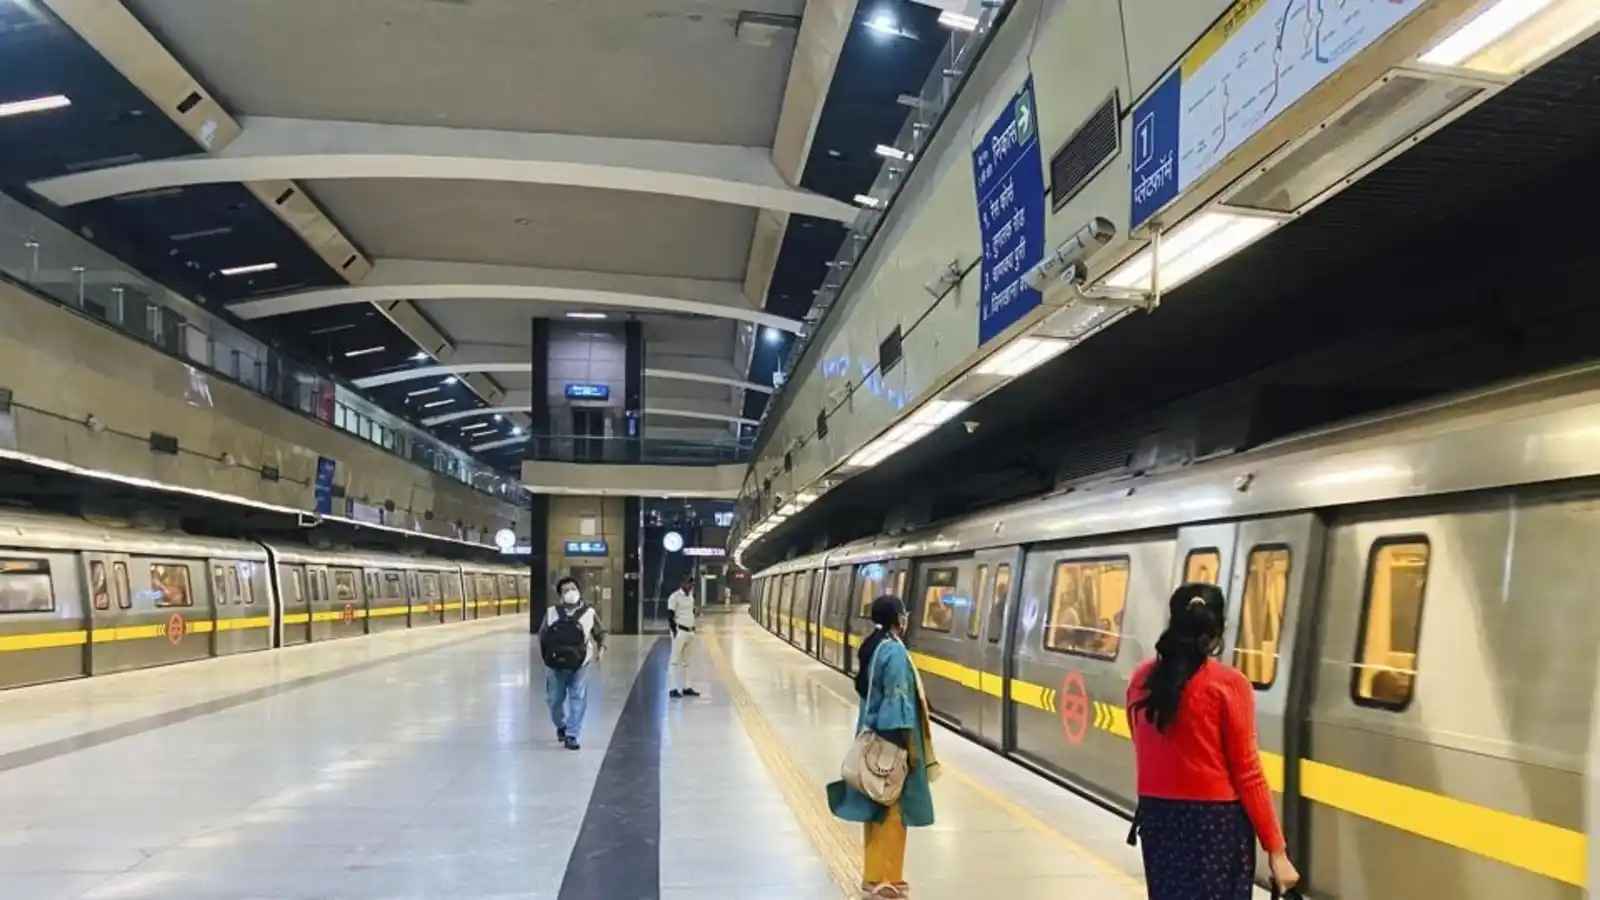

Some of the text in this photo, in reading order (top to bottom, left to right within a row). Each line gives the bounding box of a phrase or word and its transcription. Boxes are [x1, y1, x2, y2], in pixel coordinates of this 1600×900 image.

[992, 119, 1017, 165] निकास
[1140, 126, 1148, 158] 1
[1134, 150, 1173, 203] प्लेटफॉर्म
